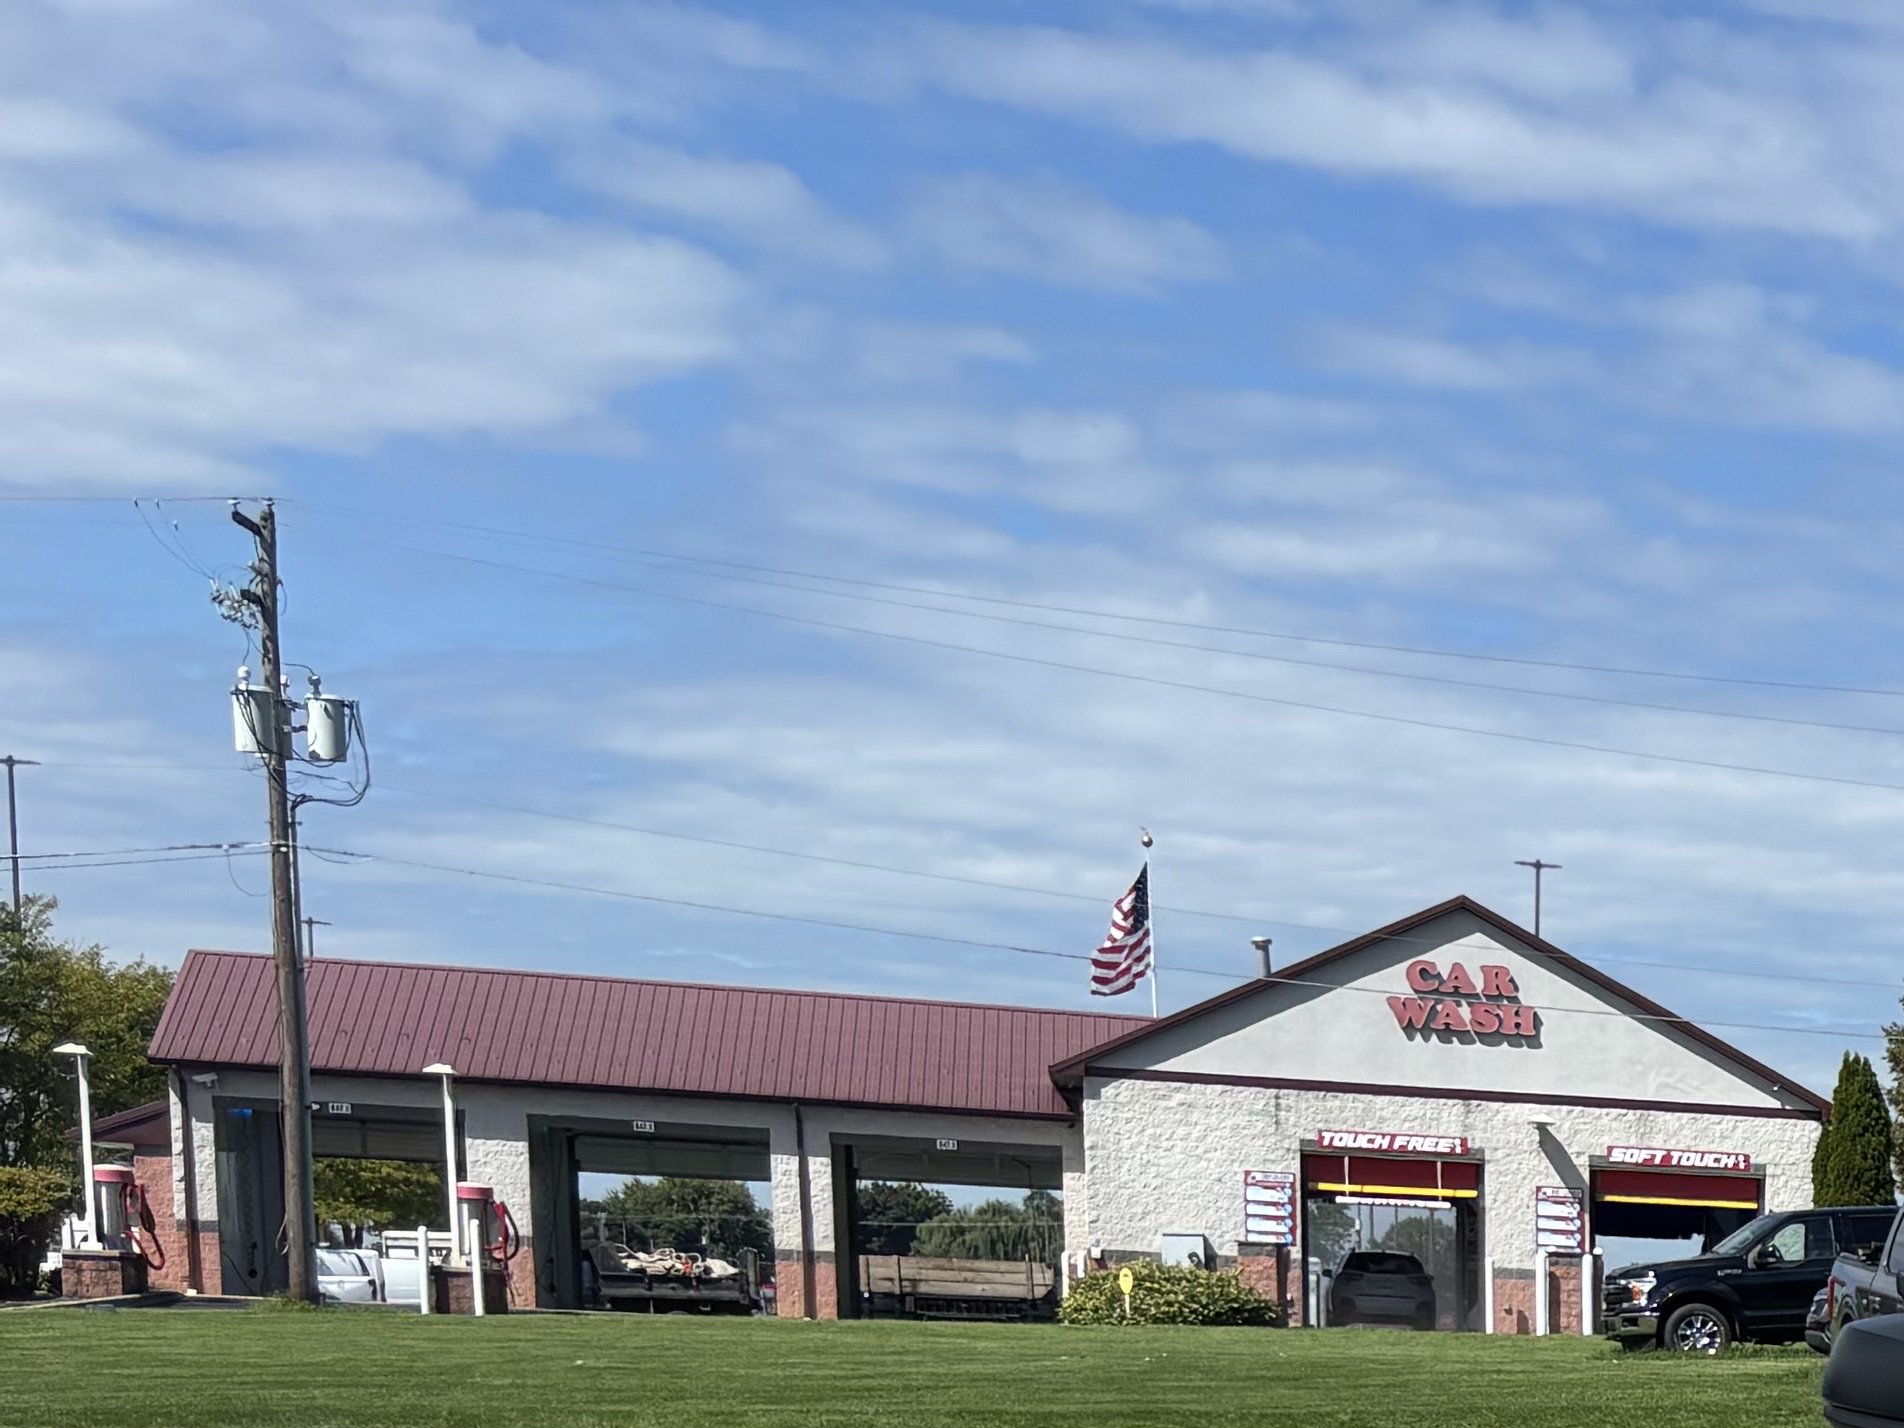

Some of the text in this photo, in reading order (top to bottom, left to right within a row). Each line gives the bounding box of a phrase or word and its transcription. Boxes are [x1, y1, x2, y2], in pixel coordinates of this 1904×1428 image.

[1405, 959, 1518, 997] CAR
[1386, 995, 1536, 1035] WASH
[1321, 1131, 1391, 1150] TOUCH
[1608, 1148, 1736, 1169] SOFT TOUCH
